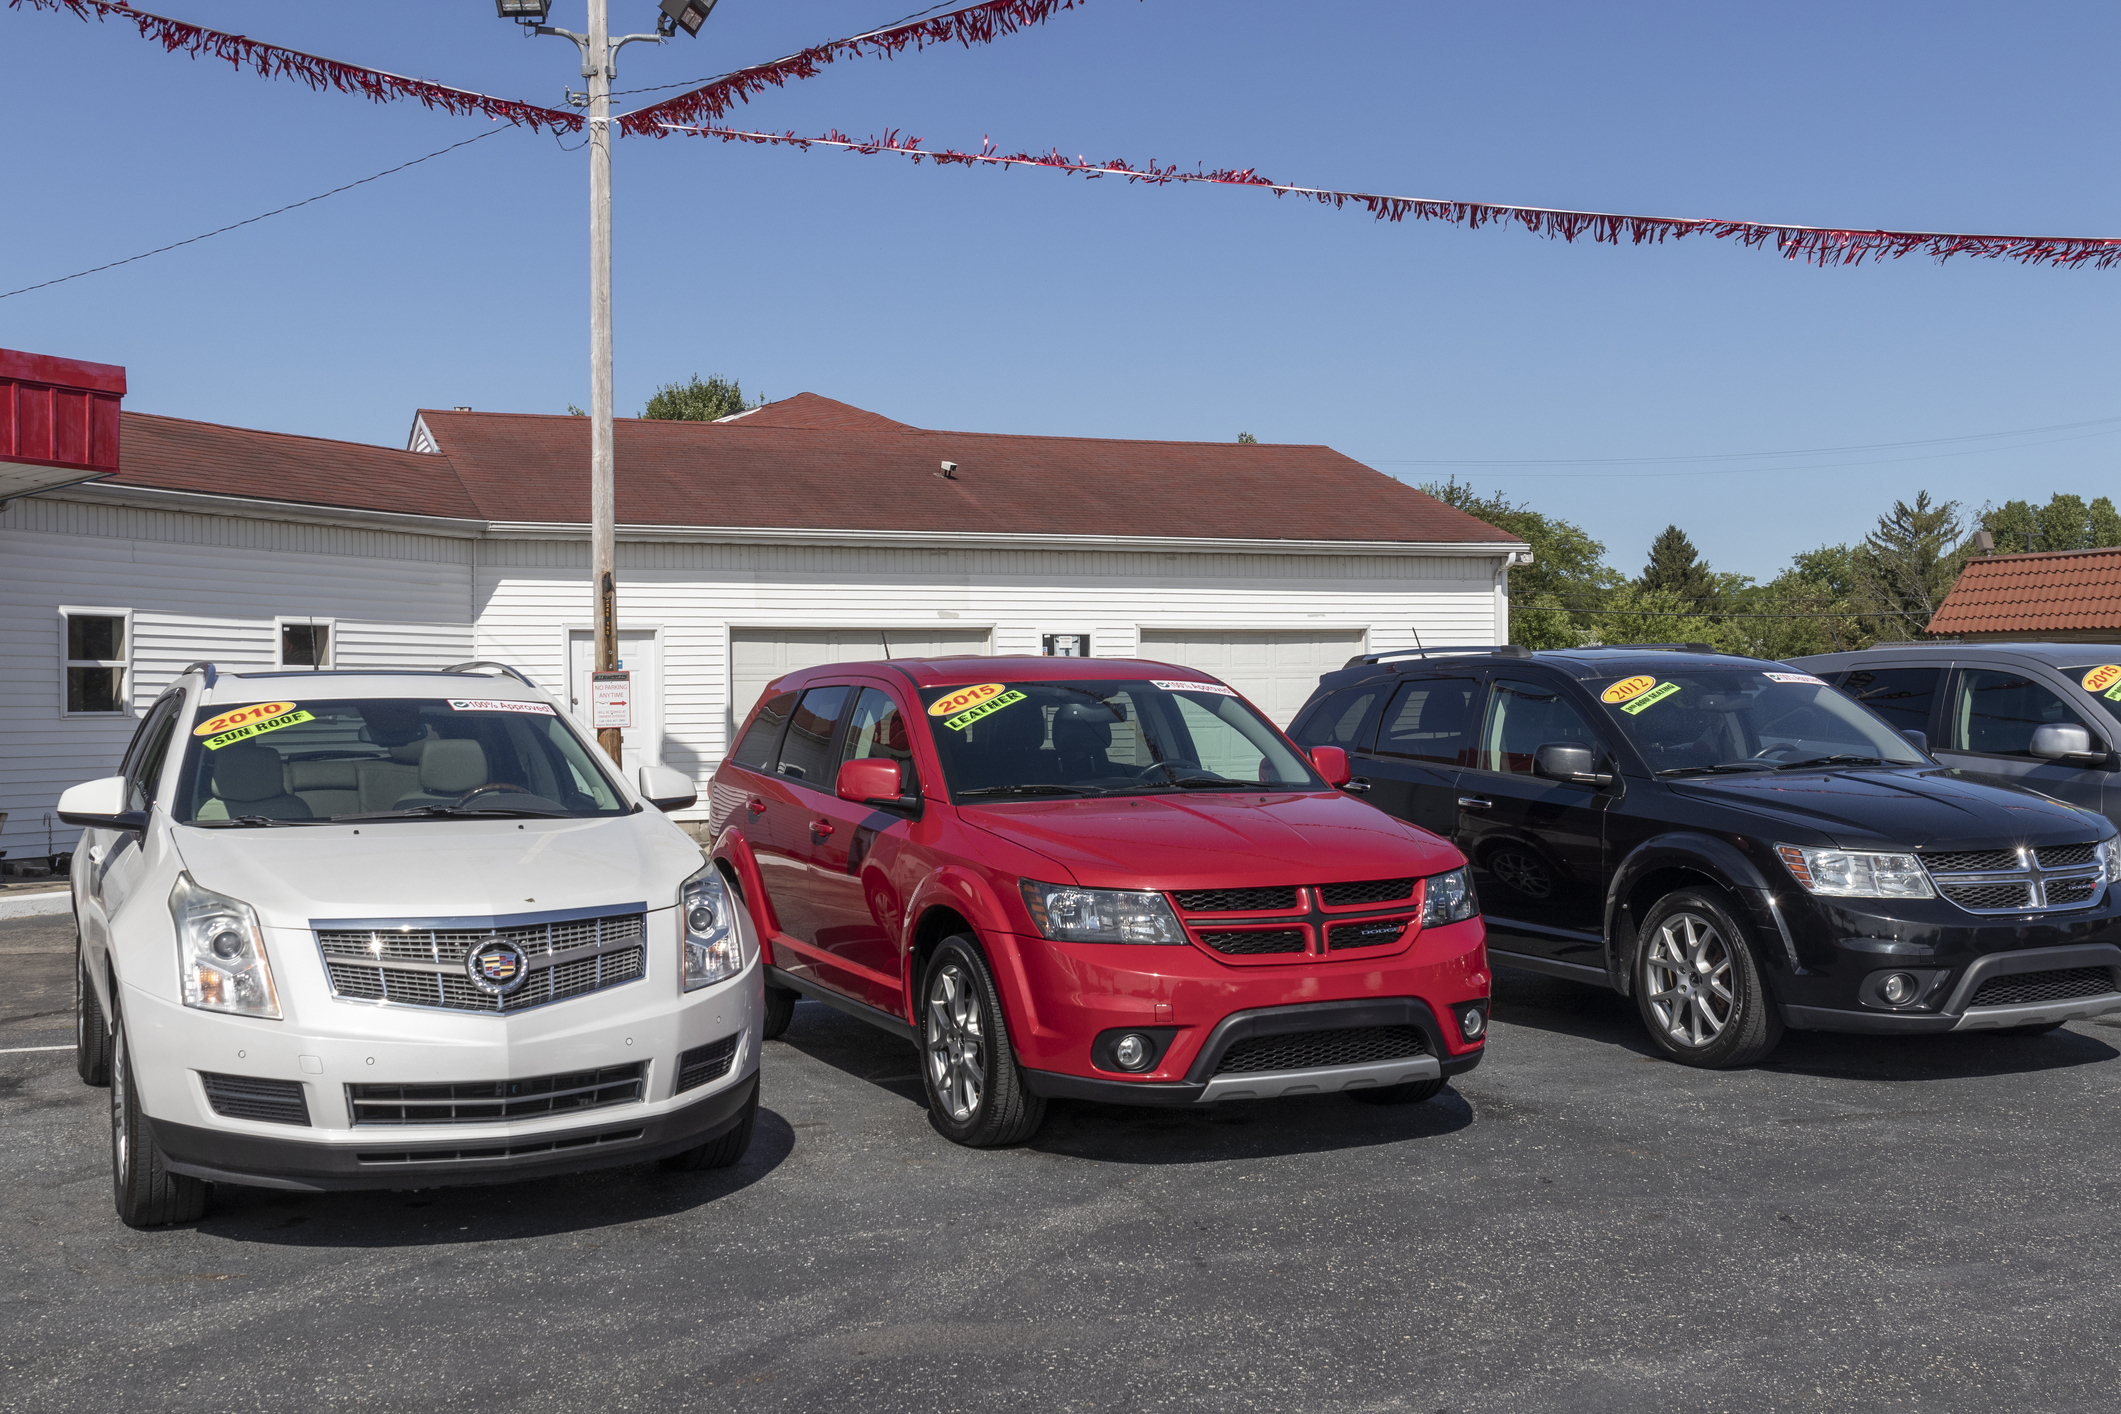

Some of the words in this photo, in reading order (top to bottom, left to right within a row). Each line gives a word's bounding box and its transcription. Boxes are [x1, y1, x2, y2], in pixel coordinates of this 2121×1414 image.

[1609, 678, 1649, 700] 2012
[2087, 666, 2118, 689] 2015
[468, 701, 499, 709] 100%
[499, 702, 553, 713] Approved!
[938, 685, 995, 713] 2015
[949, 692, 1022, 729] LEATHER
[209, 704, 282, 732] 2010
[212, 728, 252, 746] SUN
[255, 712, 305, 732] ROOF
